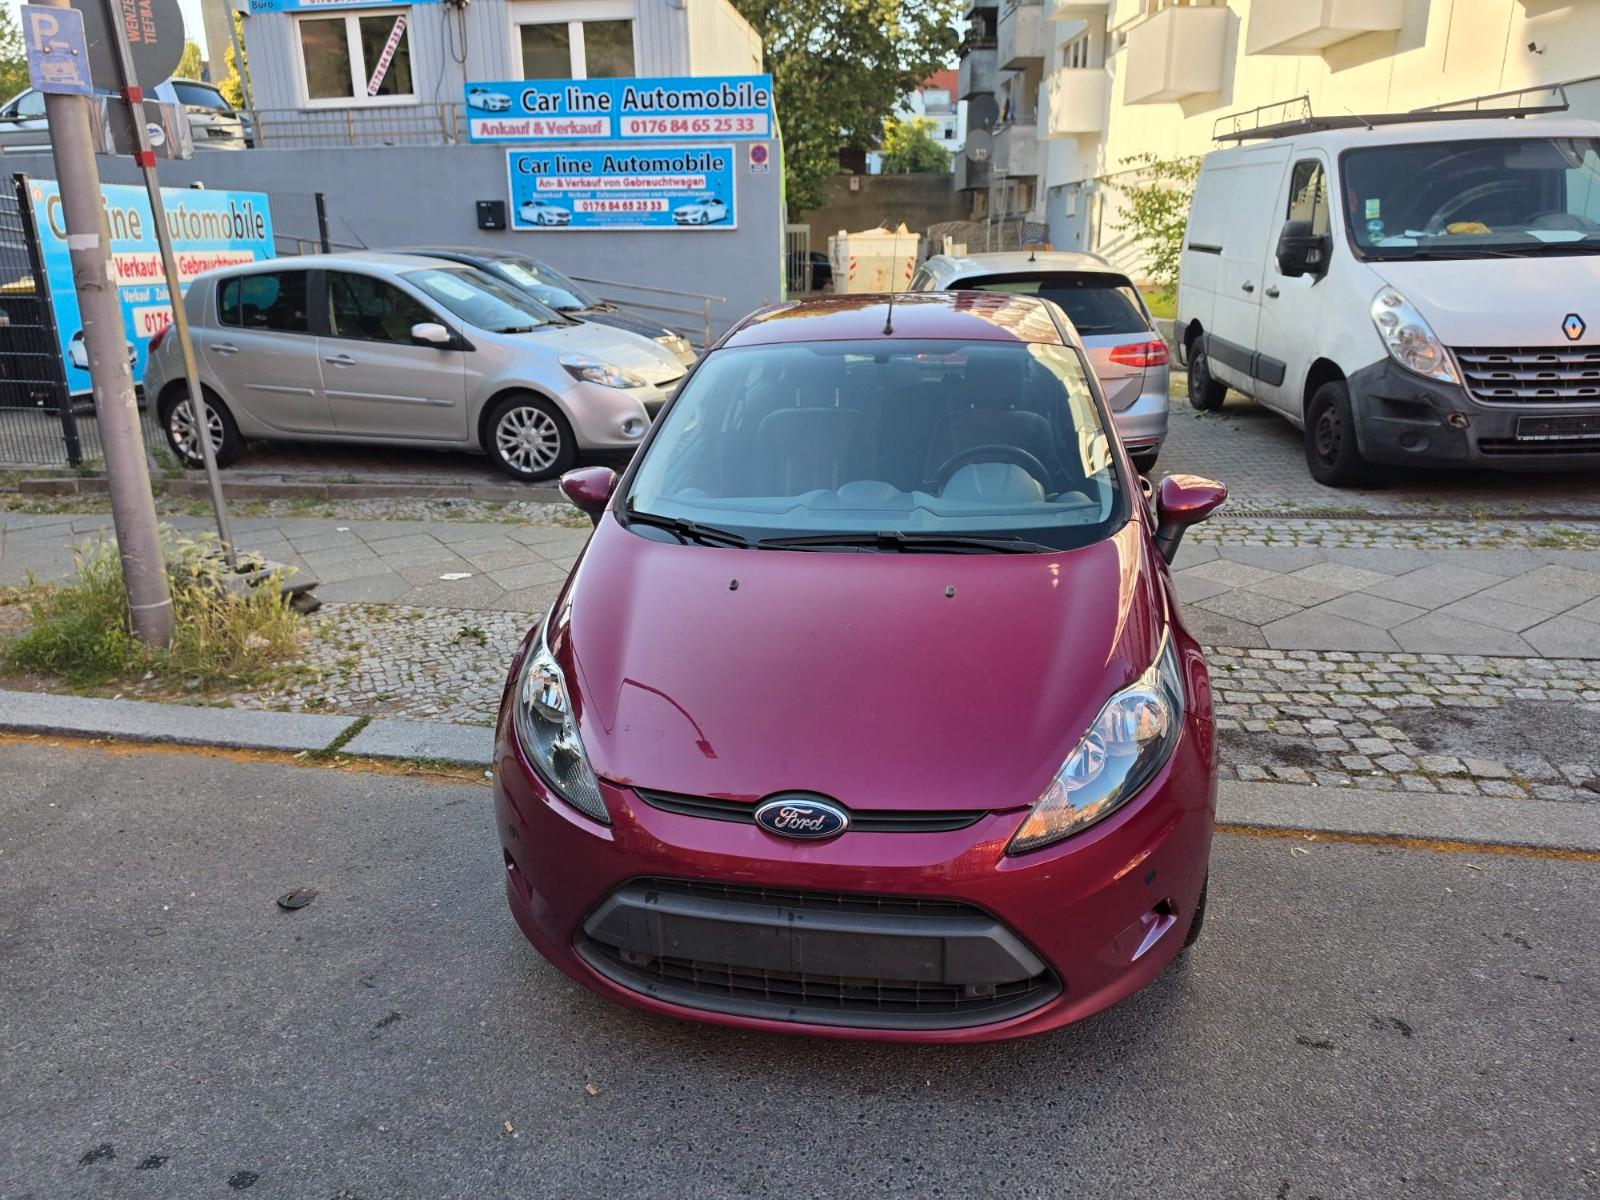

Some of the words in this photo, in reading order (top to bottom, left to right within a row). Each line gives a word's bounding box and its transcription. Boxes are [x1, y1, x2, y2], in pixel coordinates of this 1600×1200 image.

[31, 12, 60, 51] P
[522, 89, 560, 111] Car
[567, 87, 610, 111] line
[622, 84, 767, 109] Automobile
[480, 121, 530, 136] Ankauf
[533, 121, 544, 135] &
[546, 120, 603, 135] Verkauf
[630, 119, 667, 133] 0176
[670, 119, 689, 132] 84
[692, 119, 710, 132] 65
[714, 118, 733, 131] 25
[736, 118, 754, 131] 33
[518, 156, 550, 174] Car
[556, 155, 593, 174] line
[602, 152, 724, 173] Automobile
[538, 179, 555, 188] An-
[566, 178, 602, 188] Verkauf
[604, 179, 621, 187] von
[623, 177, 704, 188] Gebrauchtwagen
[582, 201, 606, 211] 0176
[608, 201, 620, 210] 84
[622, 201, 633, 210] 65
[637, 200, 648, 210] 25
[651, 200, 662, 210] 33
[102, 196, 142, 240] ine
[155, 200, 264, 240] utomobile
[115, 255, 158, 278] Verkauf
[774, 806, 825, 831] Ford
